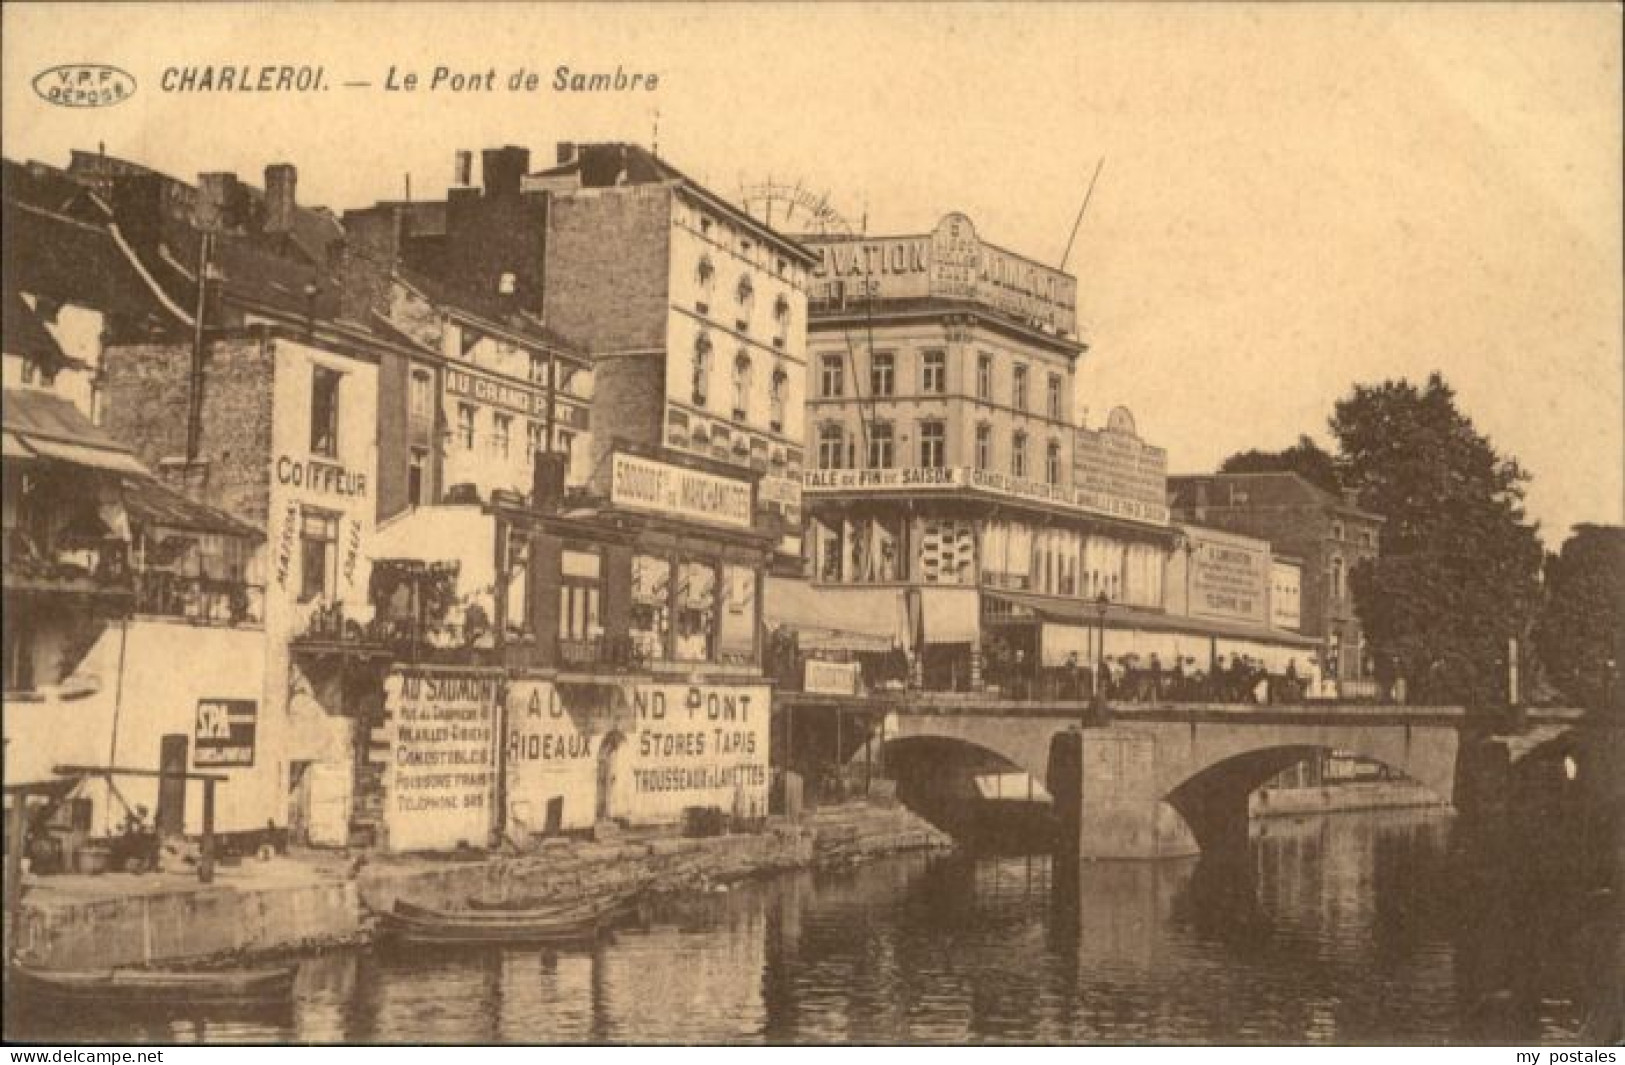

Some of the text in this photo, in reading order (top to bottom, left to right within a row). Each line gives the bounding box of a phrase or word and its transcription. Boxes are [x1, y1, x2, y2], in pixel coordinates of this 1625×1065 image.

[277, 454, 368, 498] COIFFEUR
[684, 687, 752, 723] PONT
[508, 730, 592, 760] RIDEAUX
[639, 729, 756, 758] STORES TAPIS
